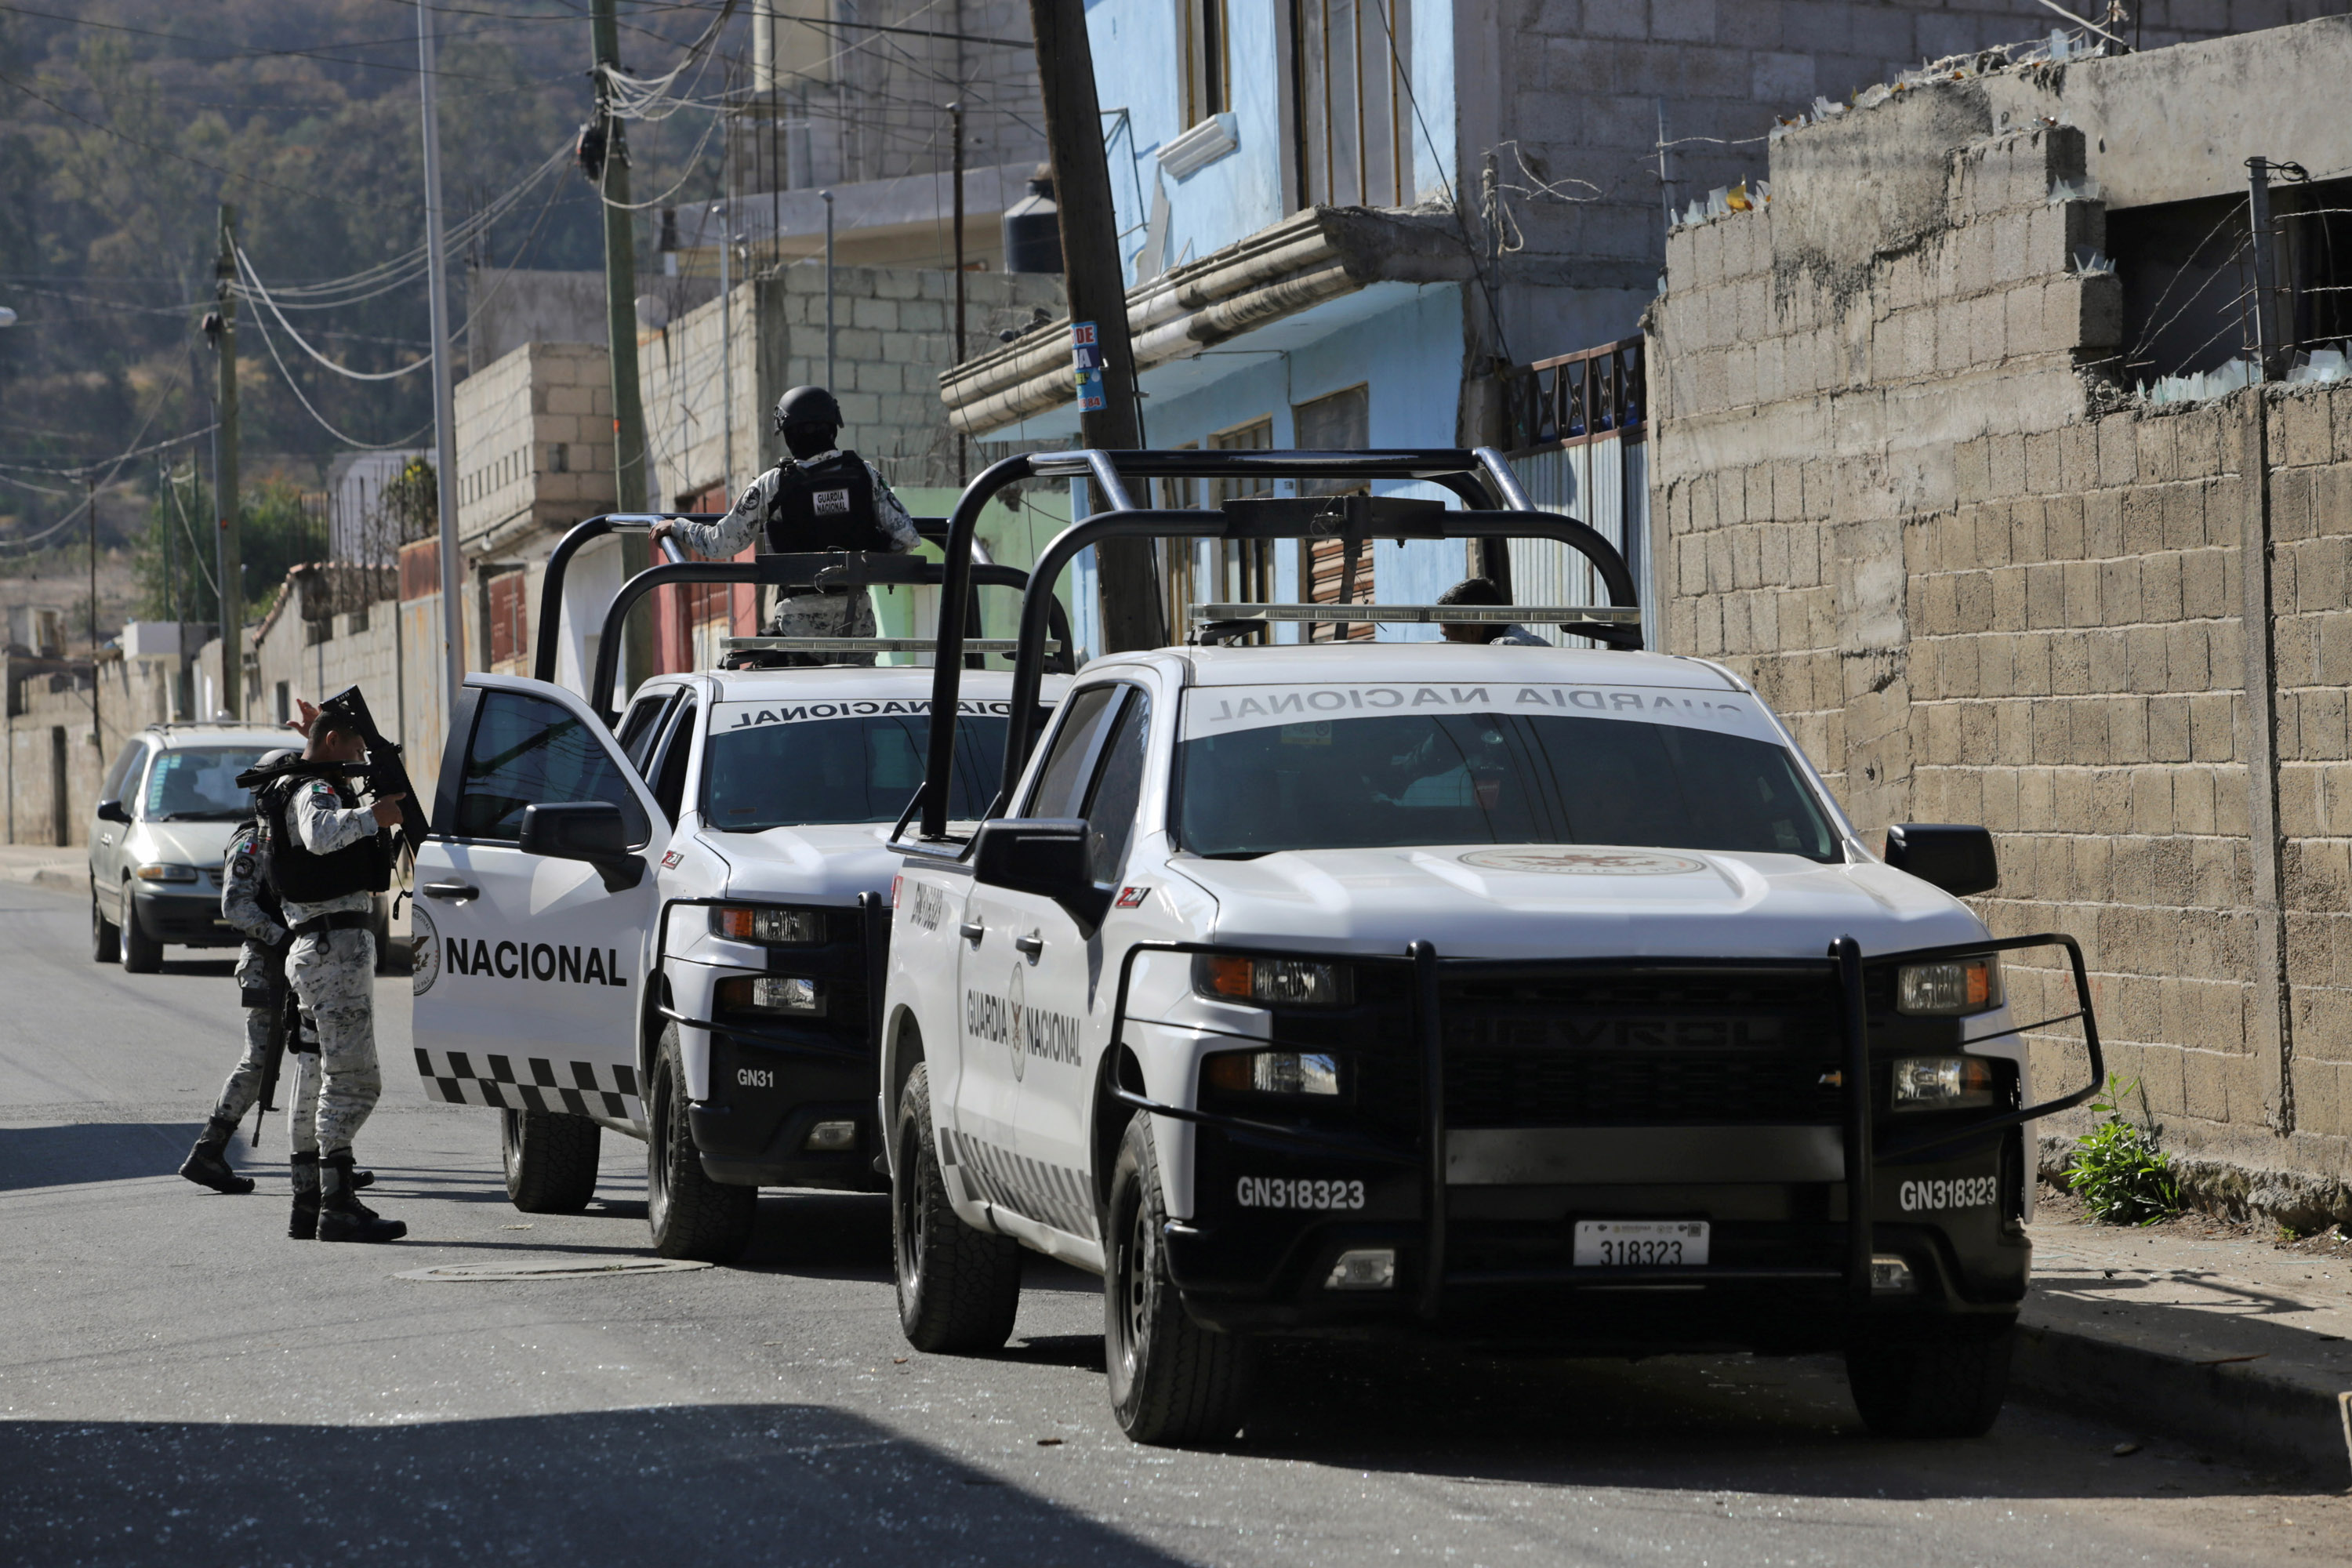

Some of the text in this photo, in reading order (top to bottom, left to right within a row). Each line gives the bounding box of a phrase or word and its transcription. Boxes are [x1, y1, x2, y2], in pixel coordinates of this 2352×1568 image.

[1076, 325, 1095, 344] DE
[817, 502, 847, 514] NACIONAL
[818, 492, 844, 503] GUARDIA
[446, 937, 627, 987] NACIONAL
[967, 989, 1082, 1067] GUARDIA NACIONAL
[737, 1068, 774, 1088] GN31
[1237, 1176, 1365, 1209] GN318323
[1900, 1176, 1997, 1211] GN318323
[1600, 1240, 1682, 1265] 318323
